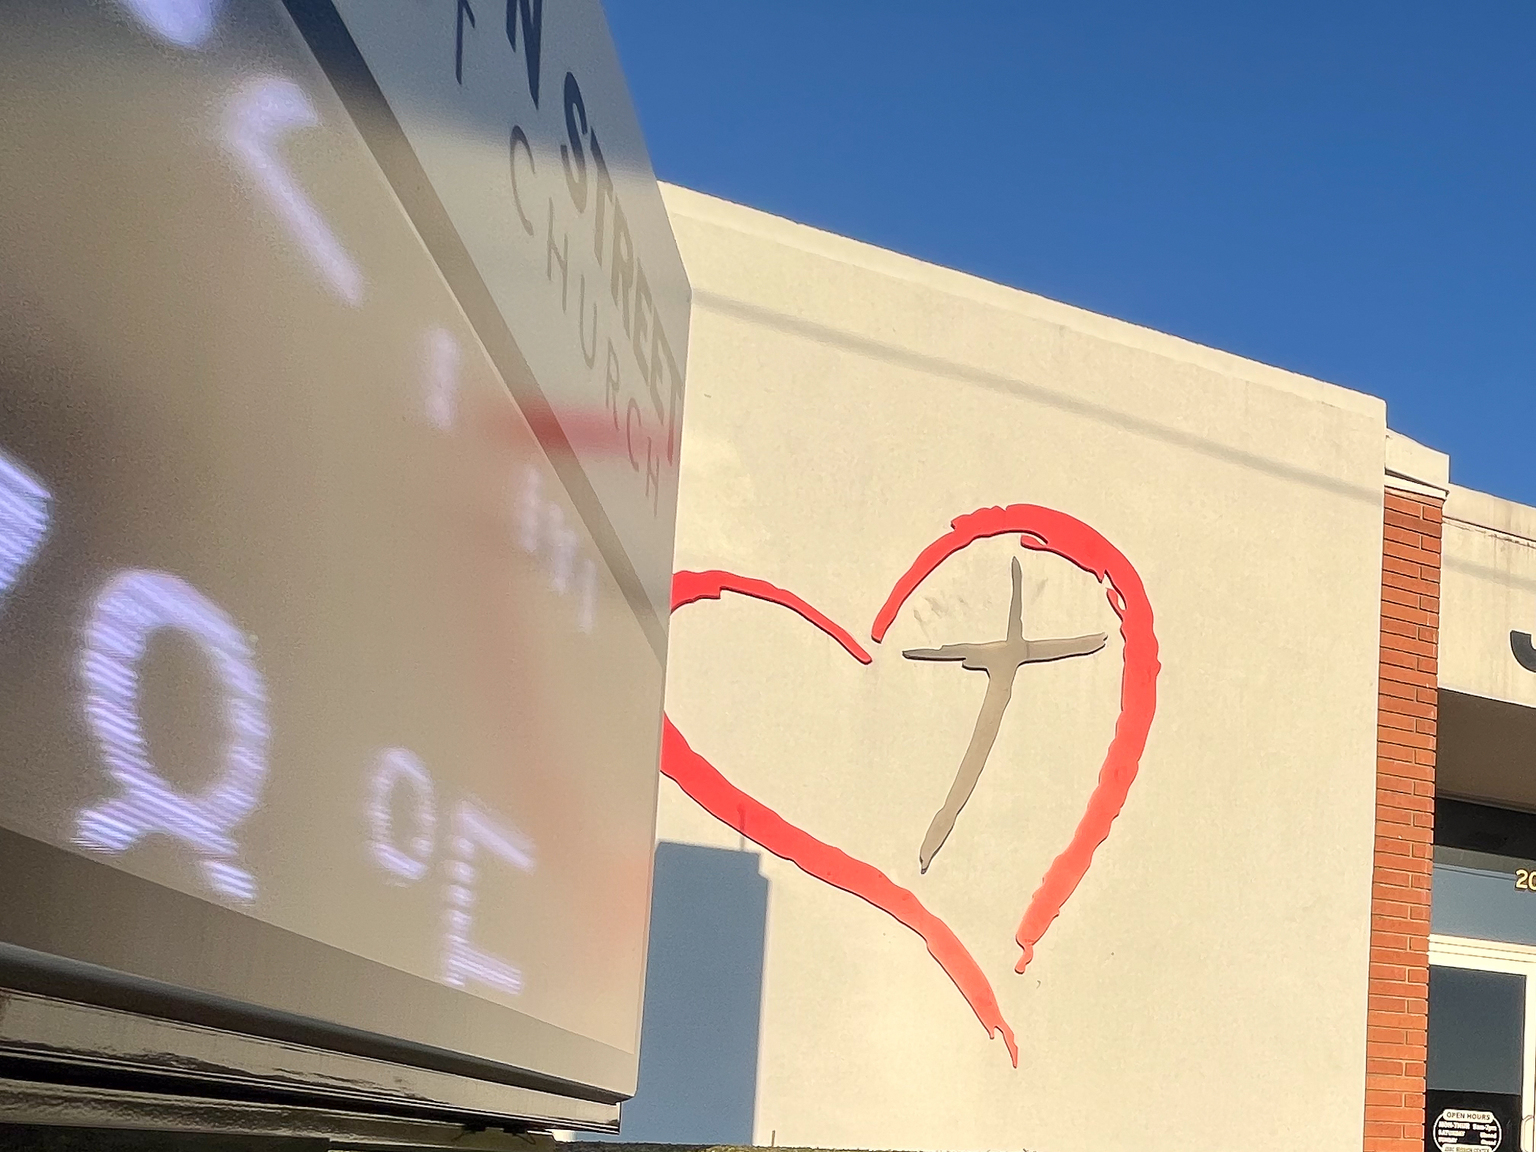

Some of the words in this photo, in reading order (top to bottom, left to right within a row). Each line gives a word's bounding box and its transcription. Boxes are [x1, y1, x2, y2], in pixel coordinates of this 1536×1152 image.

[509, 125, 661, 518] CHURCH
[559, 71, 685, 468] STREET
[1446, 1111, 1466, 1119] OPEN
[1466, 1113, 1491, 1121] HOURS
